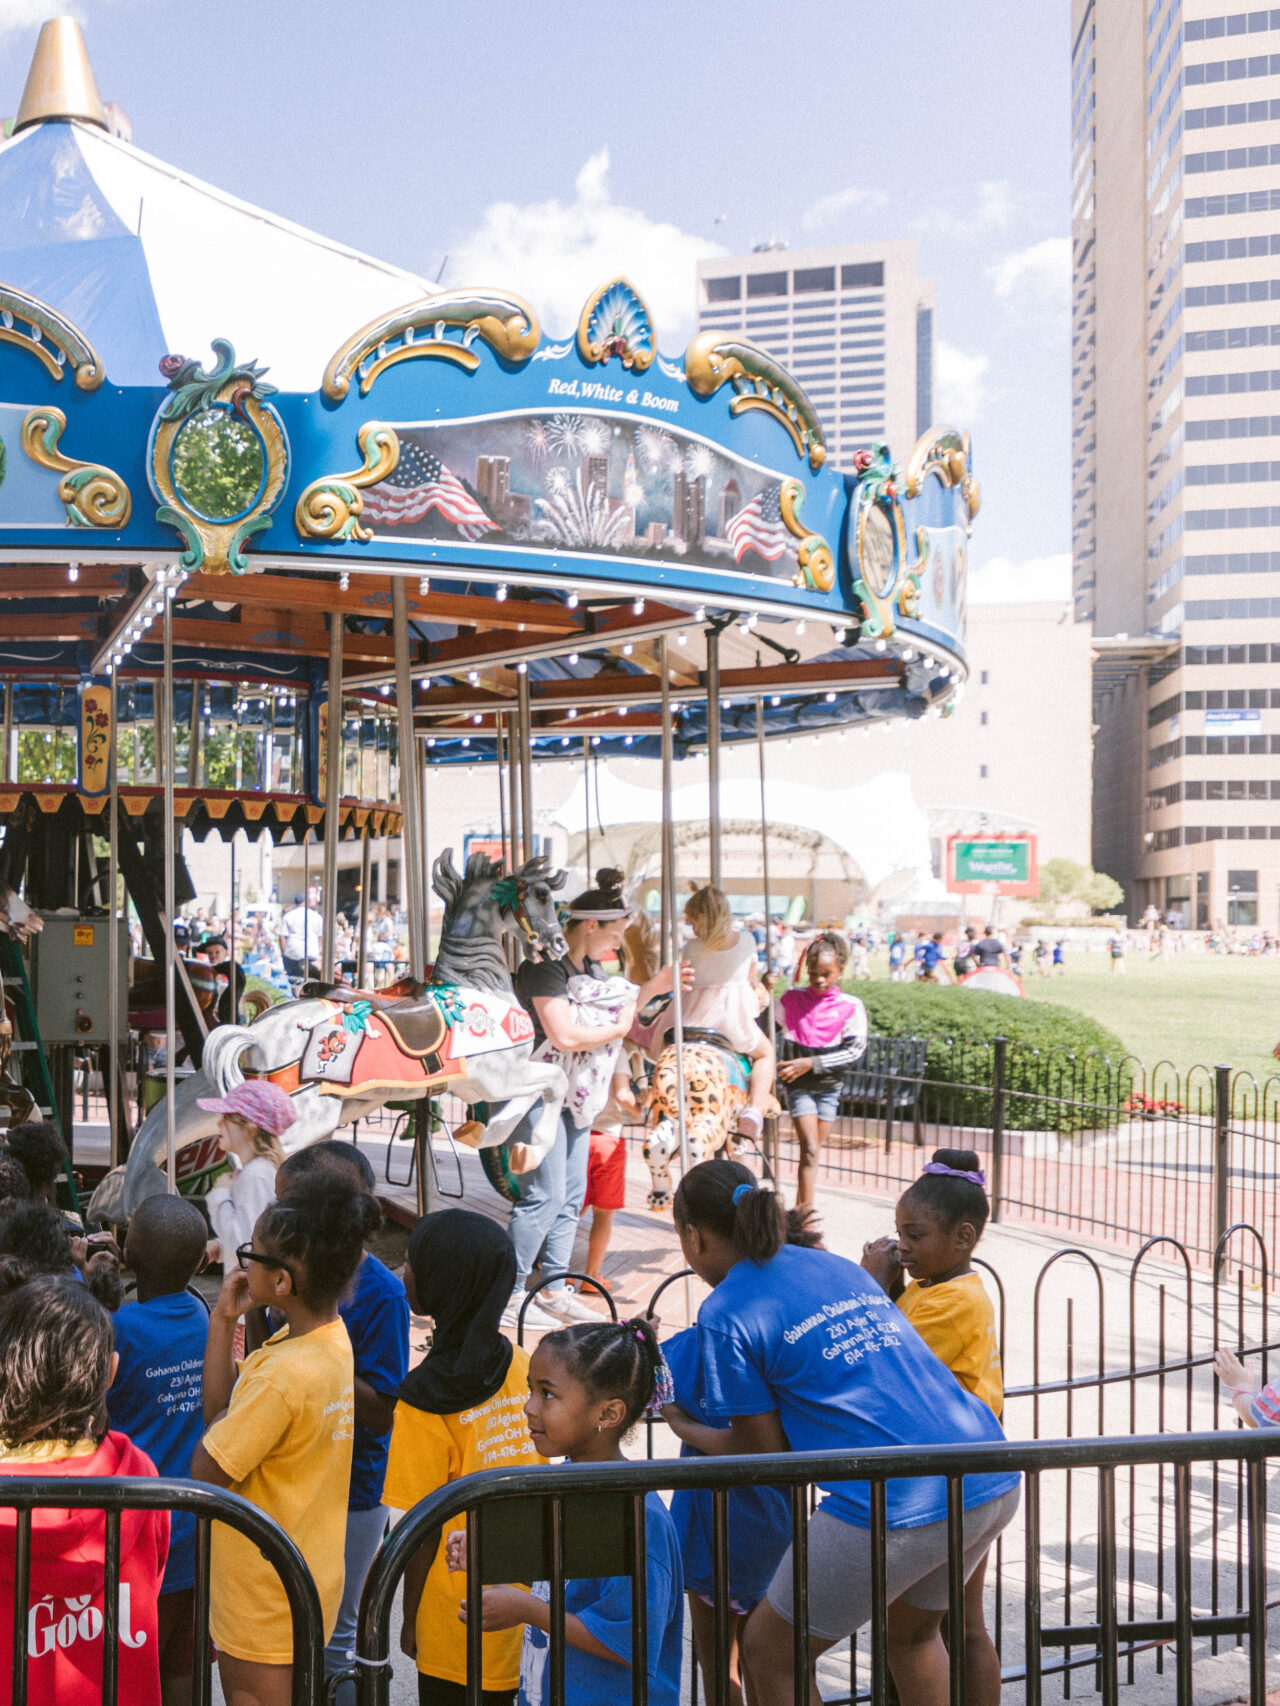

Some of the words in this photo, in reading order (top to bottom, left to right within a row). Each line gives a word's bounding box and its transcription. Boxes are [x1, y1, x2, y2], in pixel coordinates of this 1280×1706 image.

[640, 391, 679, 413] Boom
[783, 1312, 827, 1345] Gahanna
[825, 1322, 848, 1340] 230
[145, 1365, 180, 1378] Gahanna
[504, 1427, 523, 1441] OH
